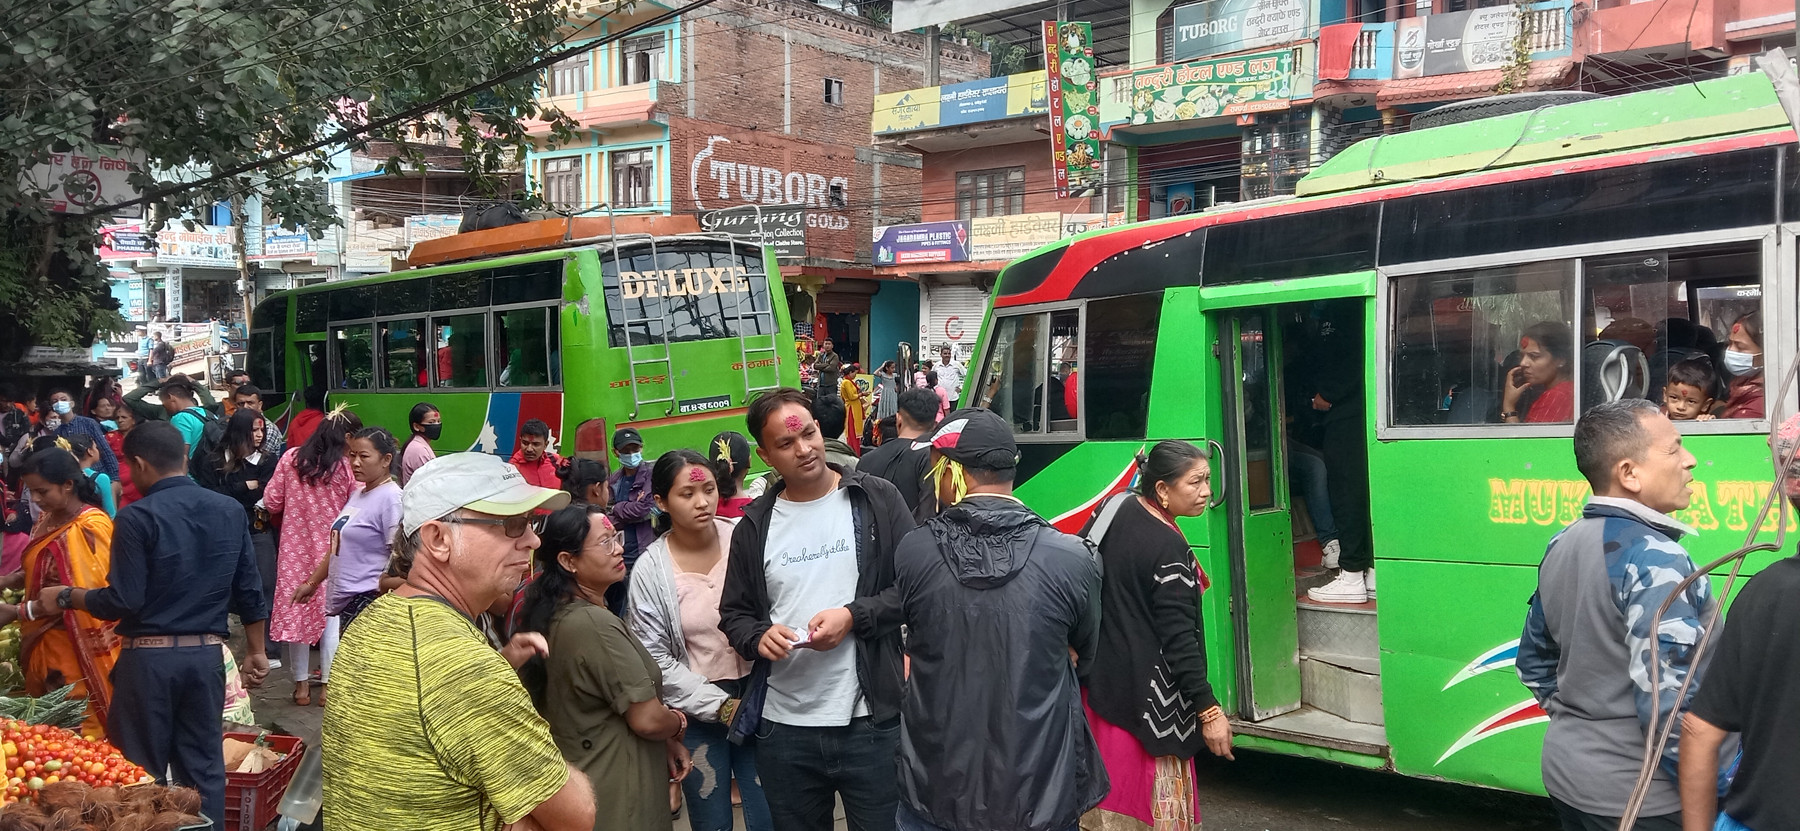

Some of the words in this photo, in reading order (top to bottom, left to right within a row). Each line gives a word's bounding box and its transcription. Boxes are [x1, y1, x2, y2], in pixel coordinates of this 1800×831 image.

[1179, 15, 1238, 43] TUBORG
[1134, 66, 1174, 91] तन्दुरी
[1176, 63, 1213, 84] होटल
[1216, 60, 1246, 76] एण्ड
[1249, 57, 1278, 73] लज
[701, 211, 802, 232] Gurung
[806, 213, 850, 230] GOLD
[774, 227, 804, 238] Collection
[929, 232, 951, 240] PLASTIC
[620, 266, 750, 300] DELUXE
